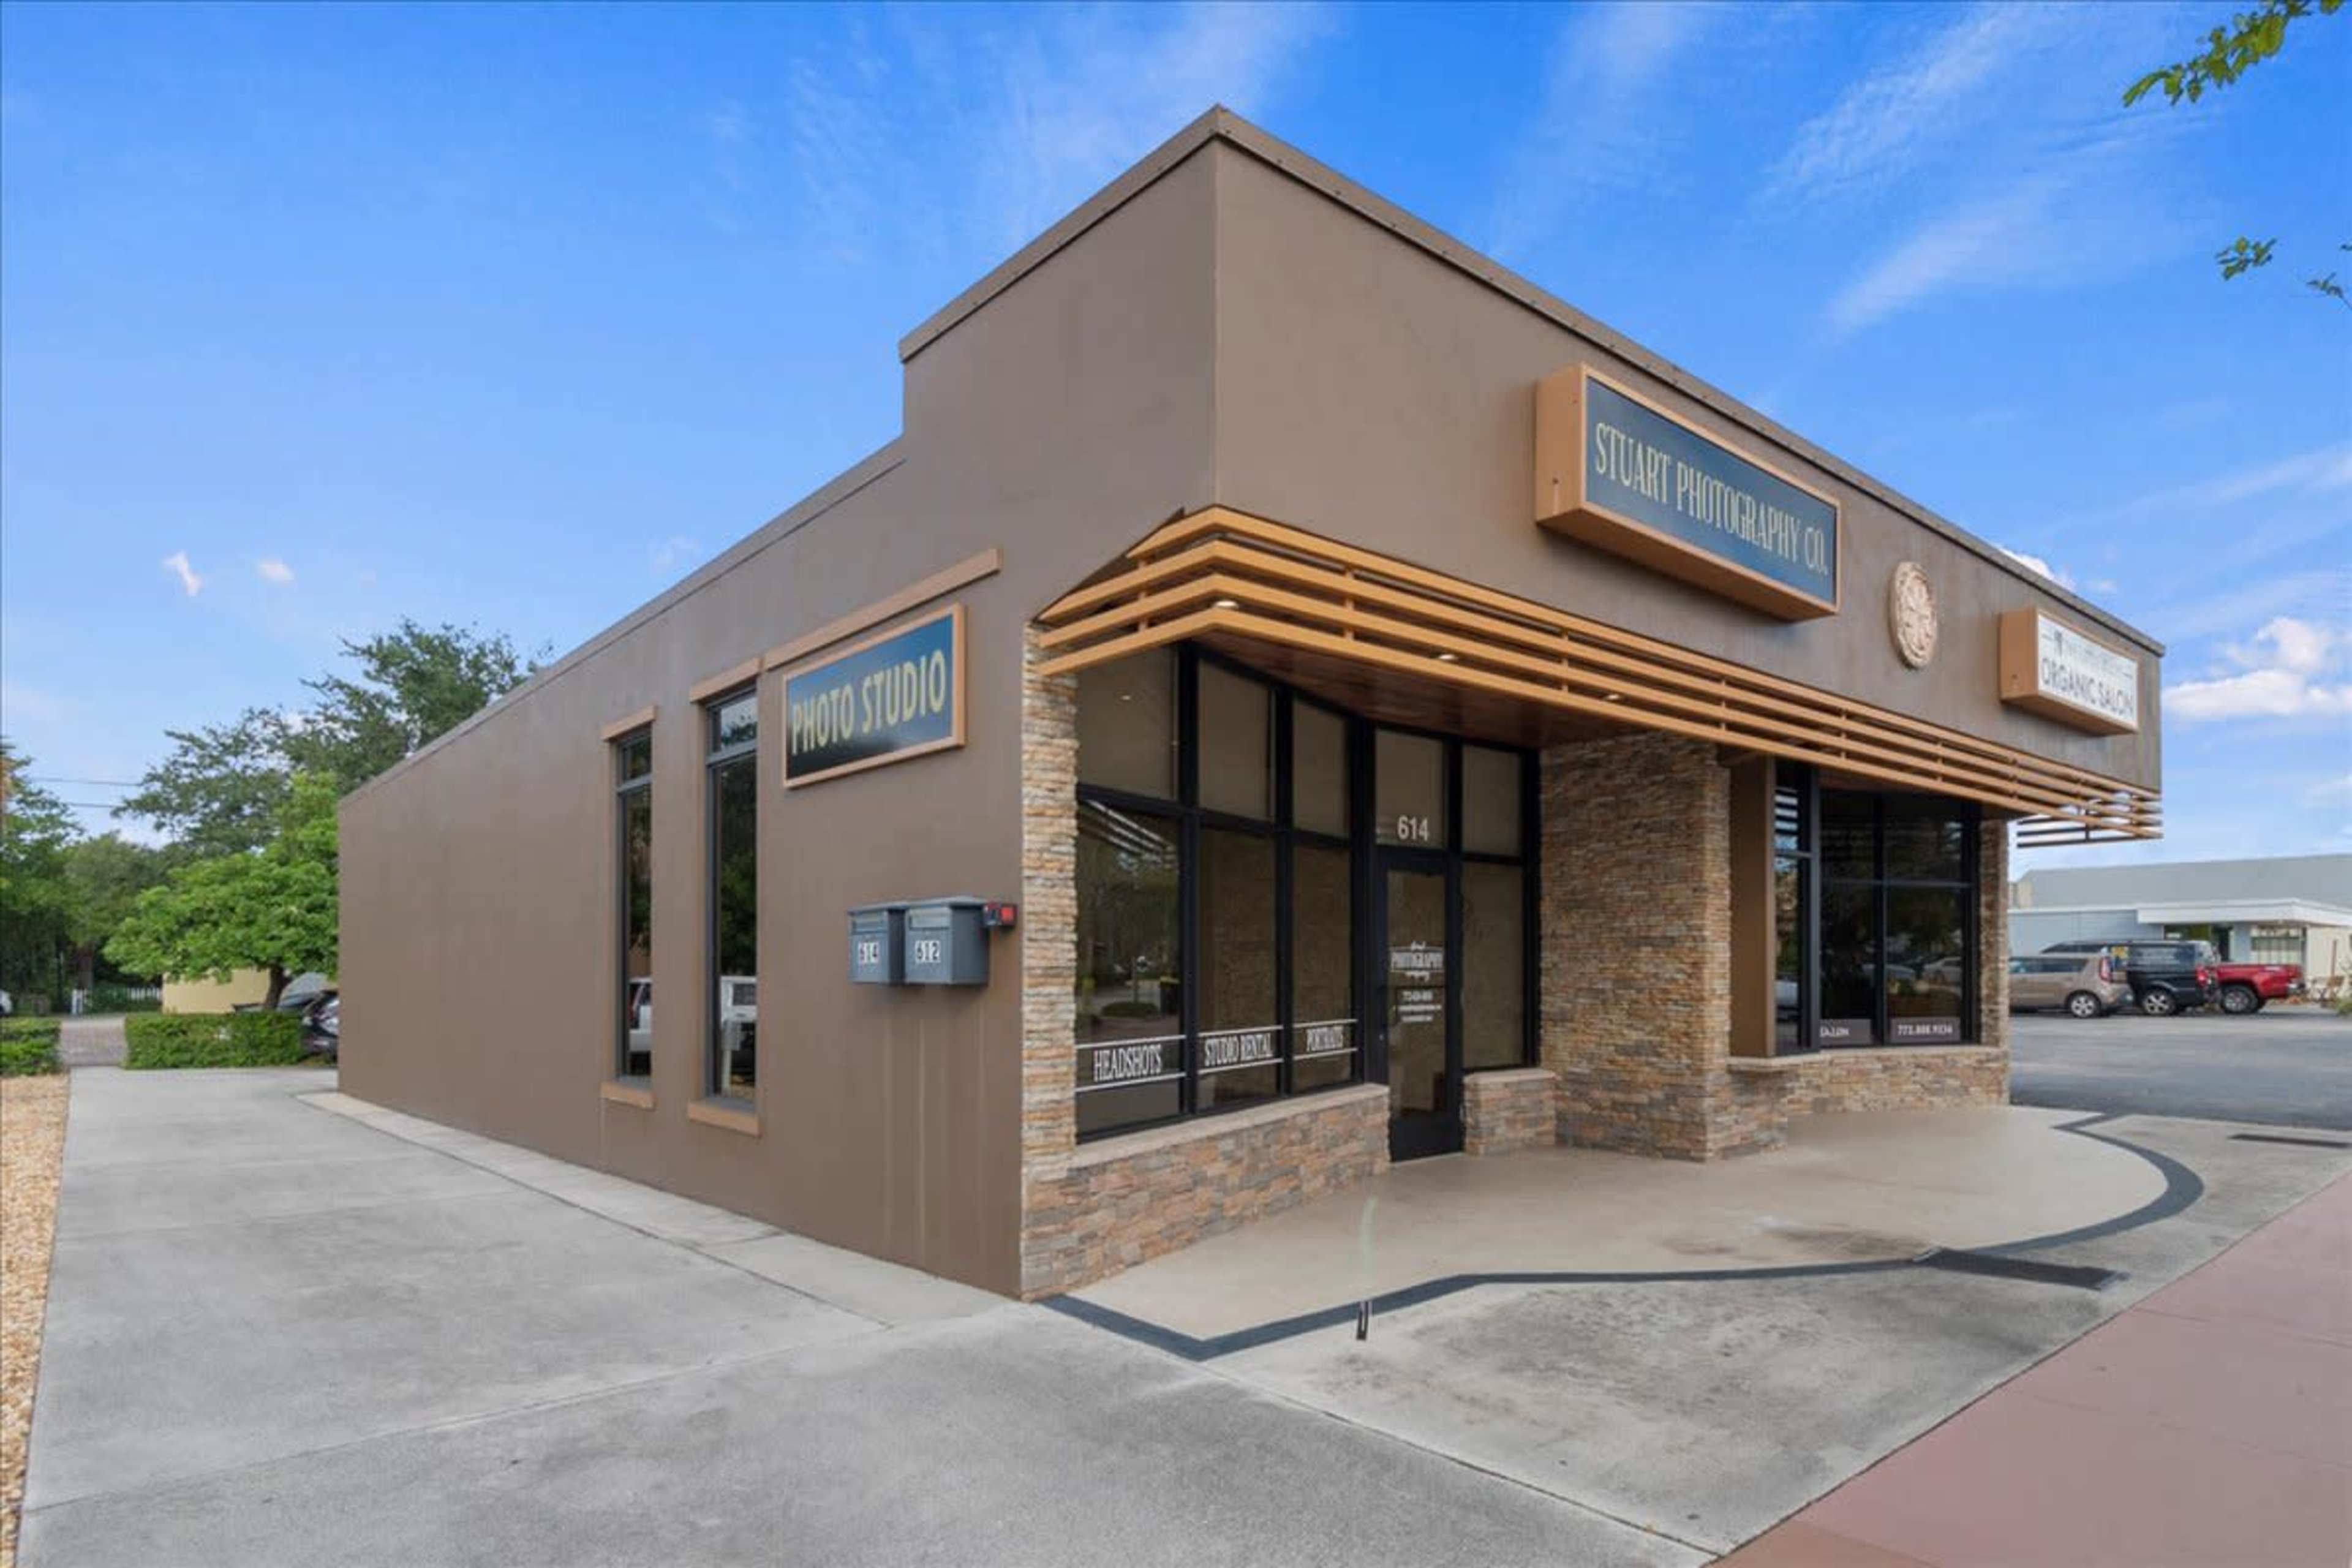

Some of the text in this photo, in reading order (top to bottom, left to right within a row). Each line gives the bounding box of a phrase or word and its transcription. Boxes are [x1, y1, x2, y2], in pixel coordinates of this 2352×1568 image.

[1596, 423, 1828, 576] STUART PHOTOGRAPHY CO.
[2042, 657, 2097, 704] ORGANIC
[792, 649, 946, 756] PHOTO STUDIO
[1396, 815, 1429, 842] 614
[1094, 1044, 1163, 1082] HEADSHOTS
[1205, 1033, 1273, 1066] STUDIO RENTAL
